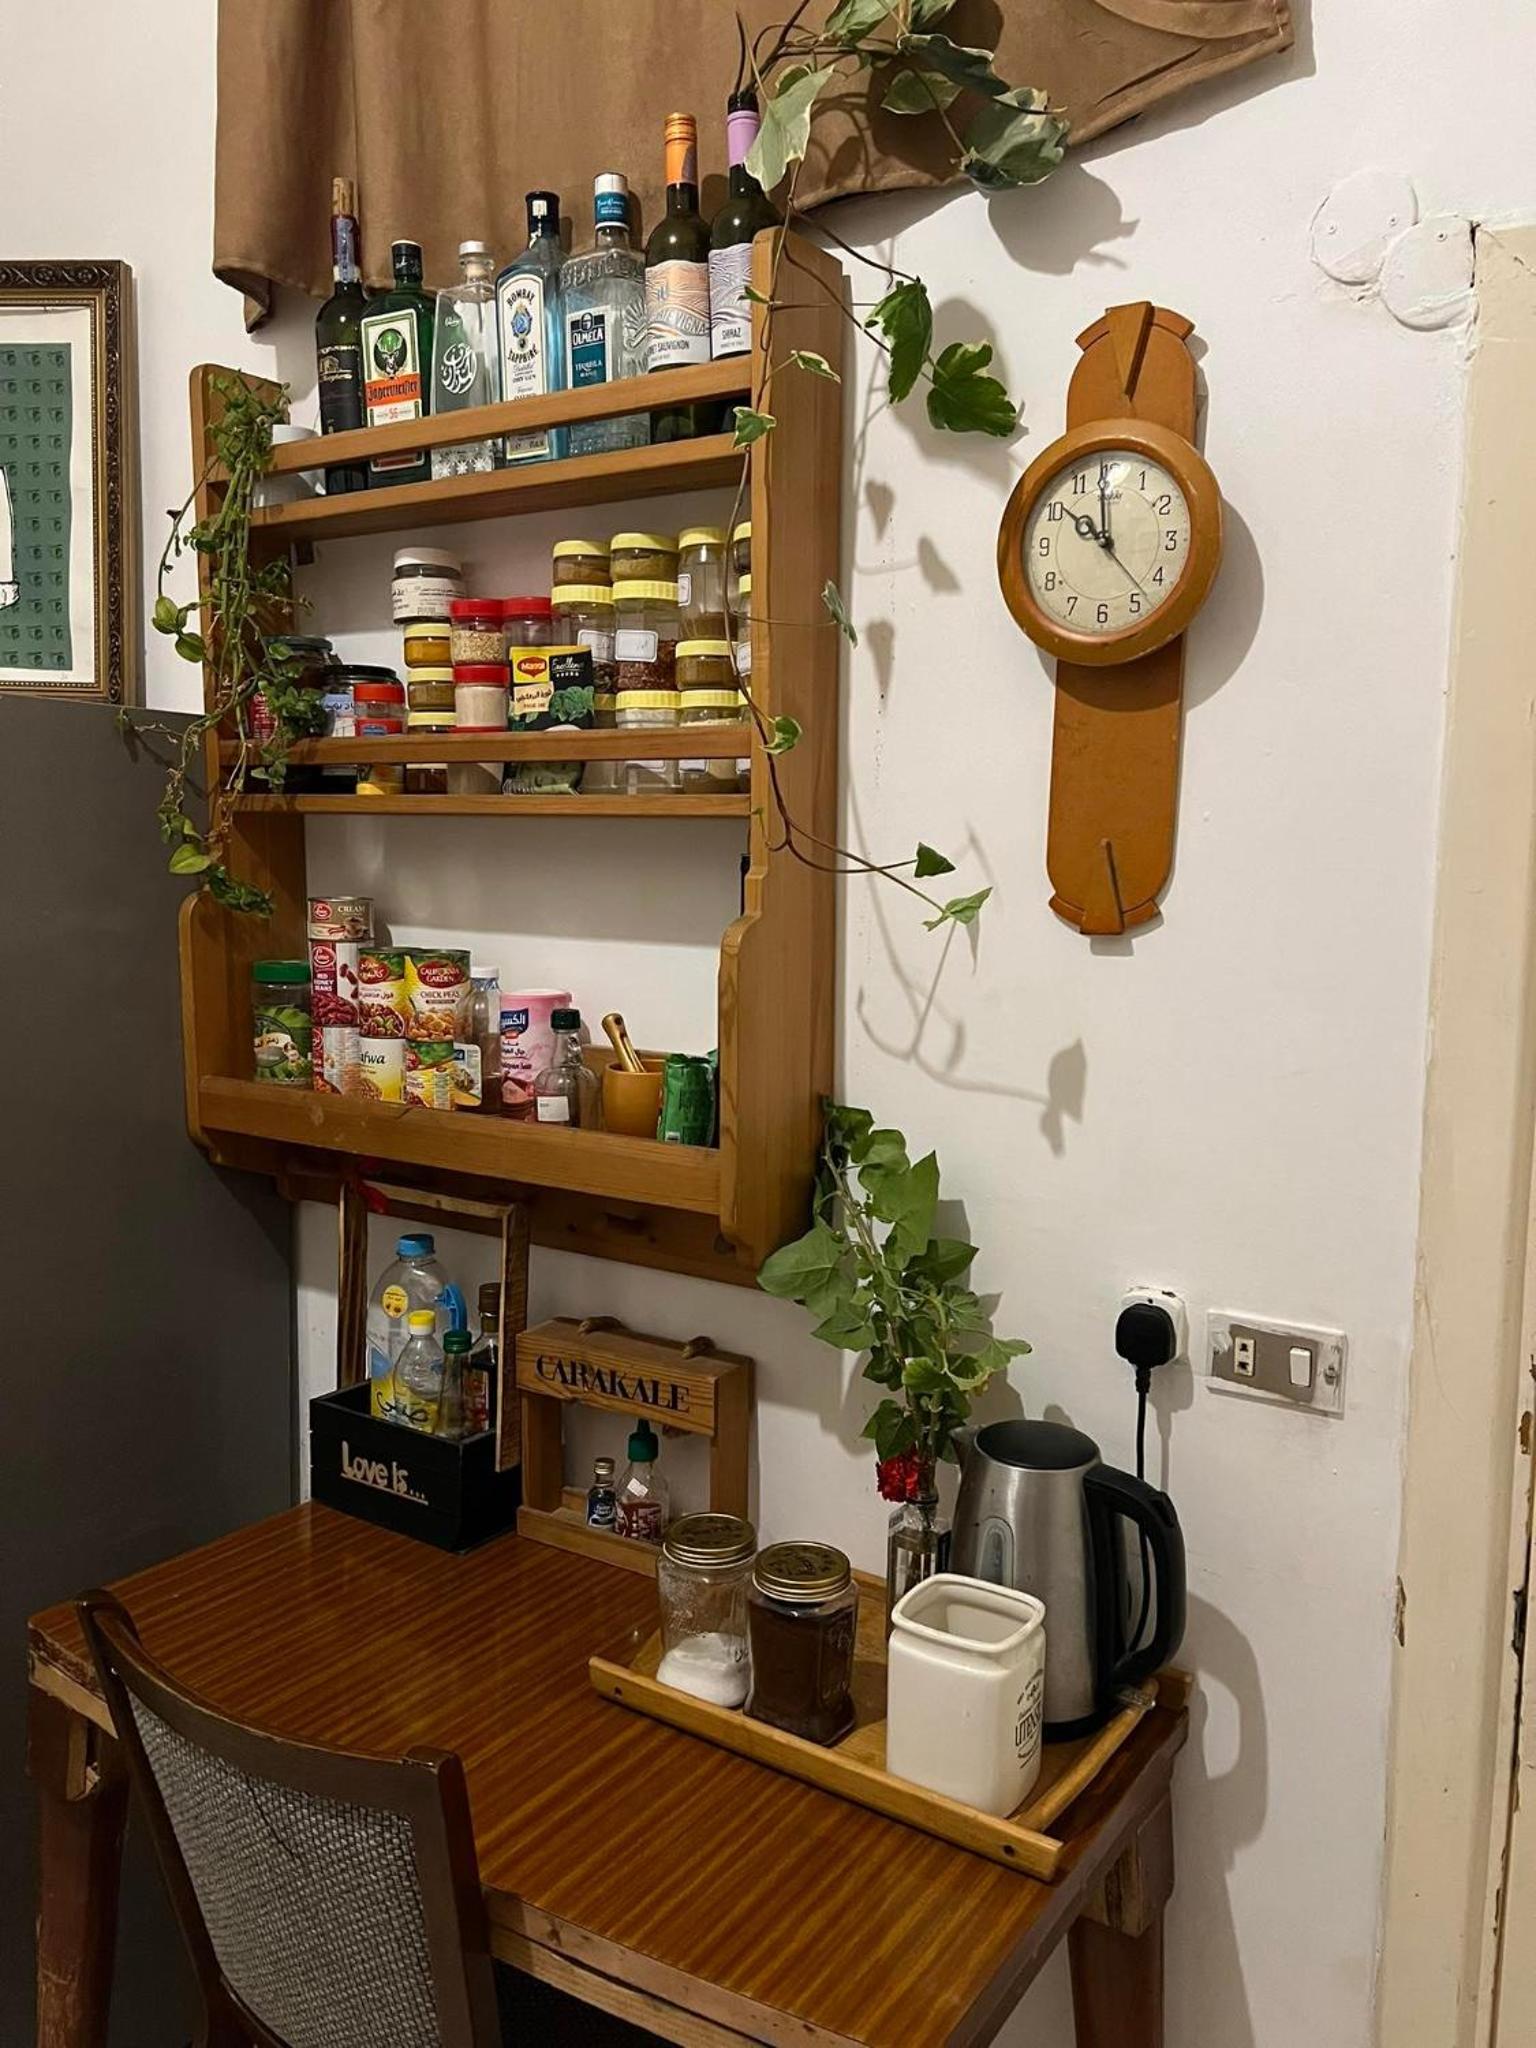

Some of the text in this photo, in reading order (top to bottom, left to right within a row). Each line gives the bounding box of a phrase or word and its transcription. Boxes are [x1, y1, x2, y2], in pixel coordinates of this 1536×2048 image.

[572, 327, 604, 346] OLMECA
[1072, 474, 1087, 494] 11
[1138, 470, 1147, 491] 1
[1048, 502, 1064, 522] 10
[1158, 495, 1172, 516] 2
[1039, 537, 1050, 557] 9
[1165, 530, 1178, 551] 3
[1044, 572, 1056, 591] 8
[1152, 566, 1164, 586] 4
[1067, 596, 1078, 617] 7
[1097, 603, 1109, 624] 6
[1129, 593, 1141, 614] 5
[337, 905, 366, 913] CREAM
[420, 991, 442, 999] CHICK
[535, 1354, 691, 1414] CARAKALE
[341, 1440, 389, 1487] Love
